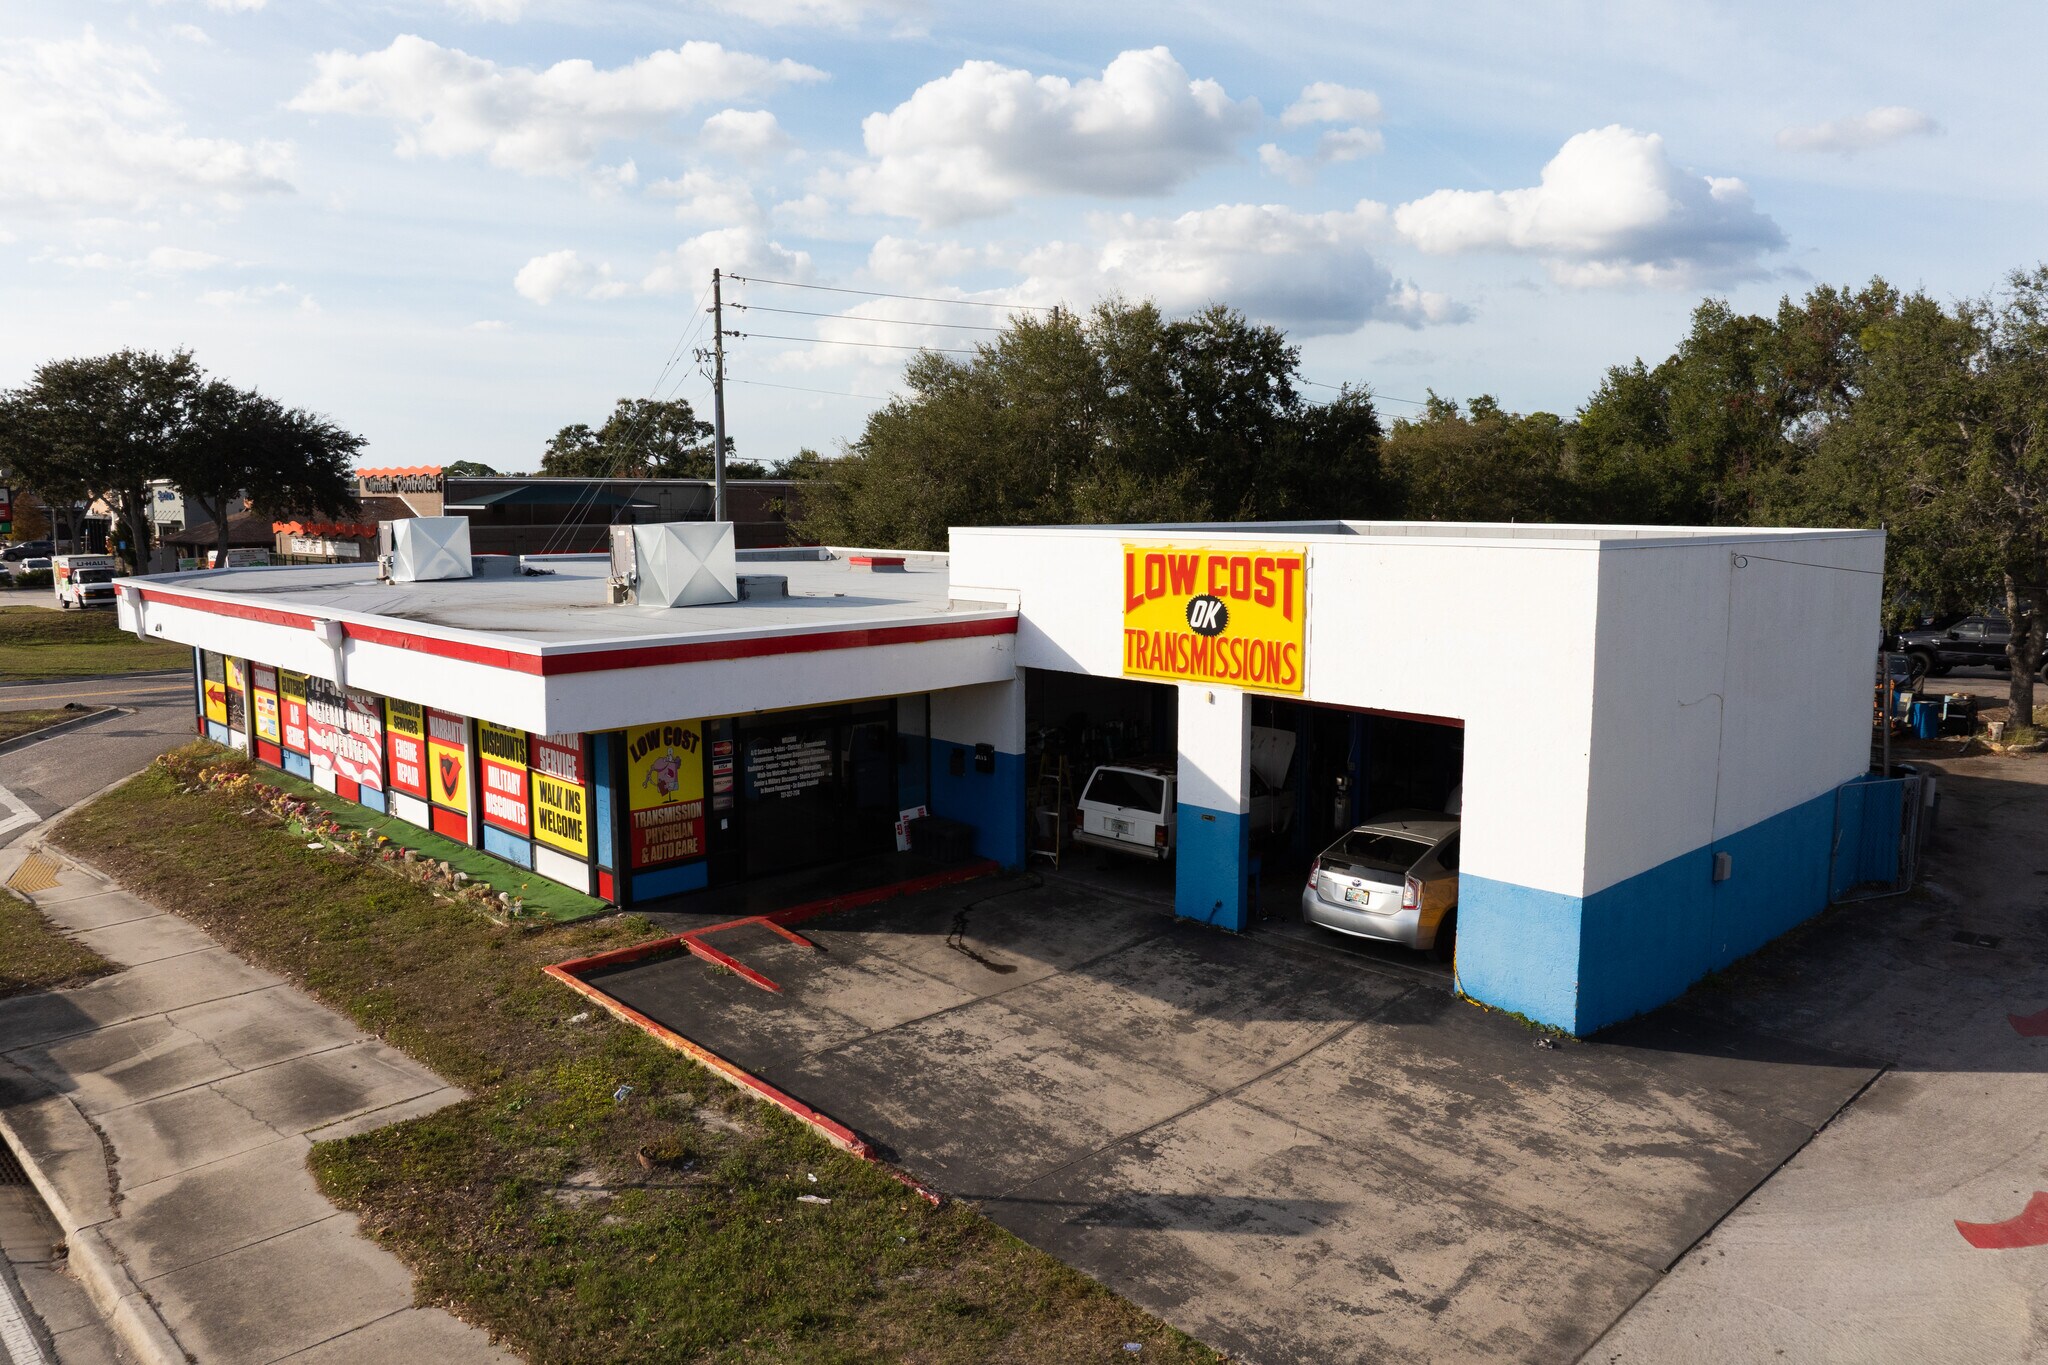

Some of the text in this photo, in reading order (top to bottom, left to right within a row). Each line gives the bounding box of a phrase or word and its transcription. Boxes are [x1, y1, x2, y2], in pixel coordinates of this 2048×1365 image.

[365, 475, 437, 492] Climate Controlled
[1126, 553, 1300, 623] LOW COST
[1190, 600, 1222, 630] OK
[1124, 628, 1297, 686] TRANSMISSIONS
[310, 699, 345, 730] VETERAN
[346, 710, 376, 739] OWNED
[393, 715, 419, 736] SERVICES
[328, 731, 369, 765] OPERATED
[395, 738, 418, 763] ENGINE
[481, 728, 525, 765] DISCOUNTS
[536, 733, 580, 752] DIATOR
[629, 725, 700, 764] LOW COST
[396, 761, 420, 788] REPAIR
[539, 746, 578, 782] SERVICE
[487, 765, 521, 797] MILITARY
[538, 780, 581, 815] WALK INS
[485, 791, 527, 827] DISCOUNTS
[538, 806, 583, 843] WELCOME
[633, 801, 703, 829] TRANSMISSION
[645, 821, 694, 845] PHYSICIAN
[641, 846, 650, 864] &
